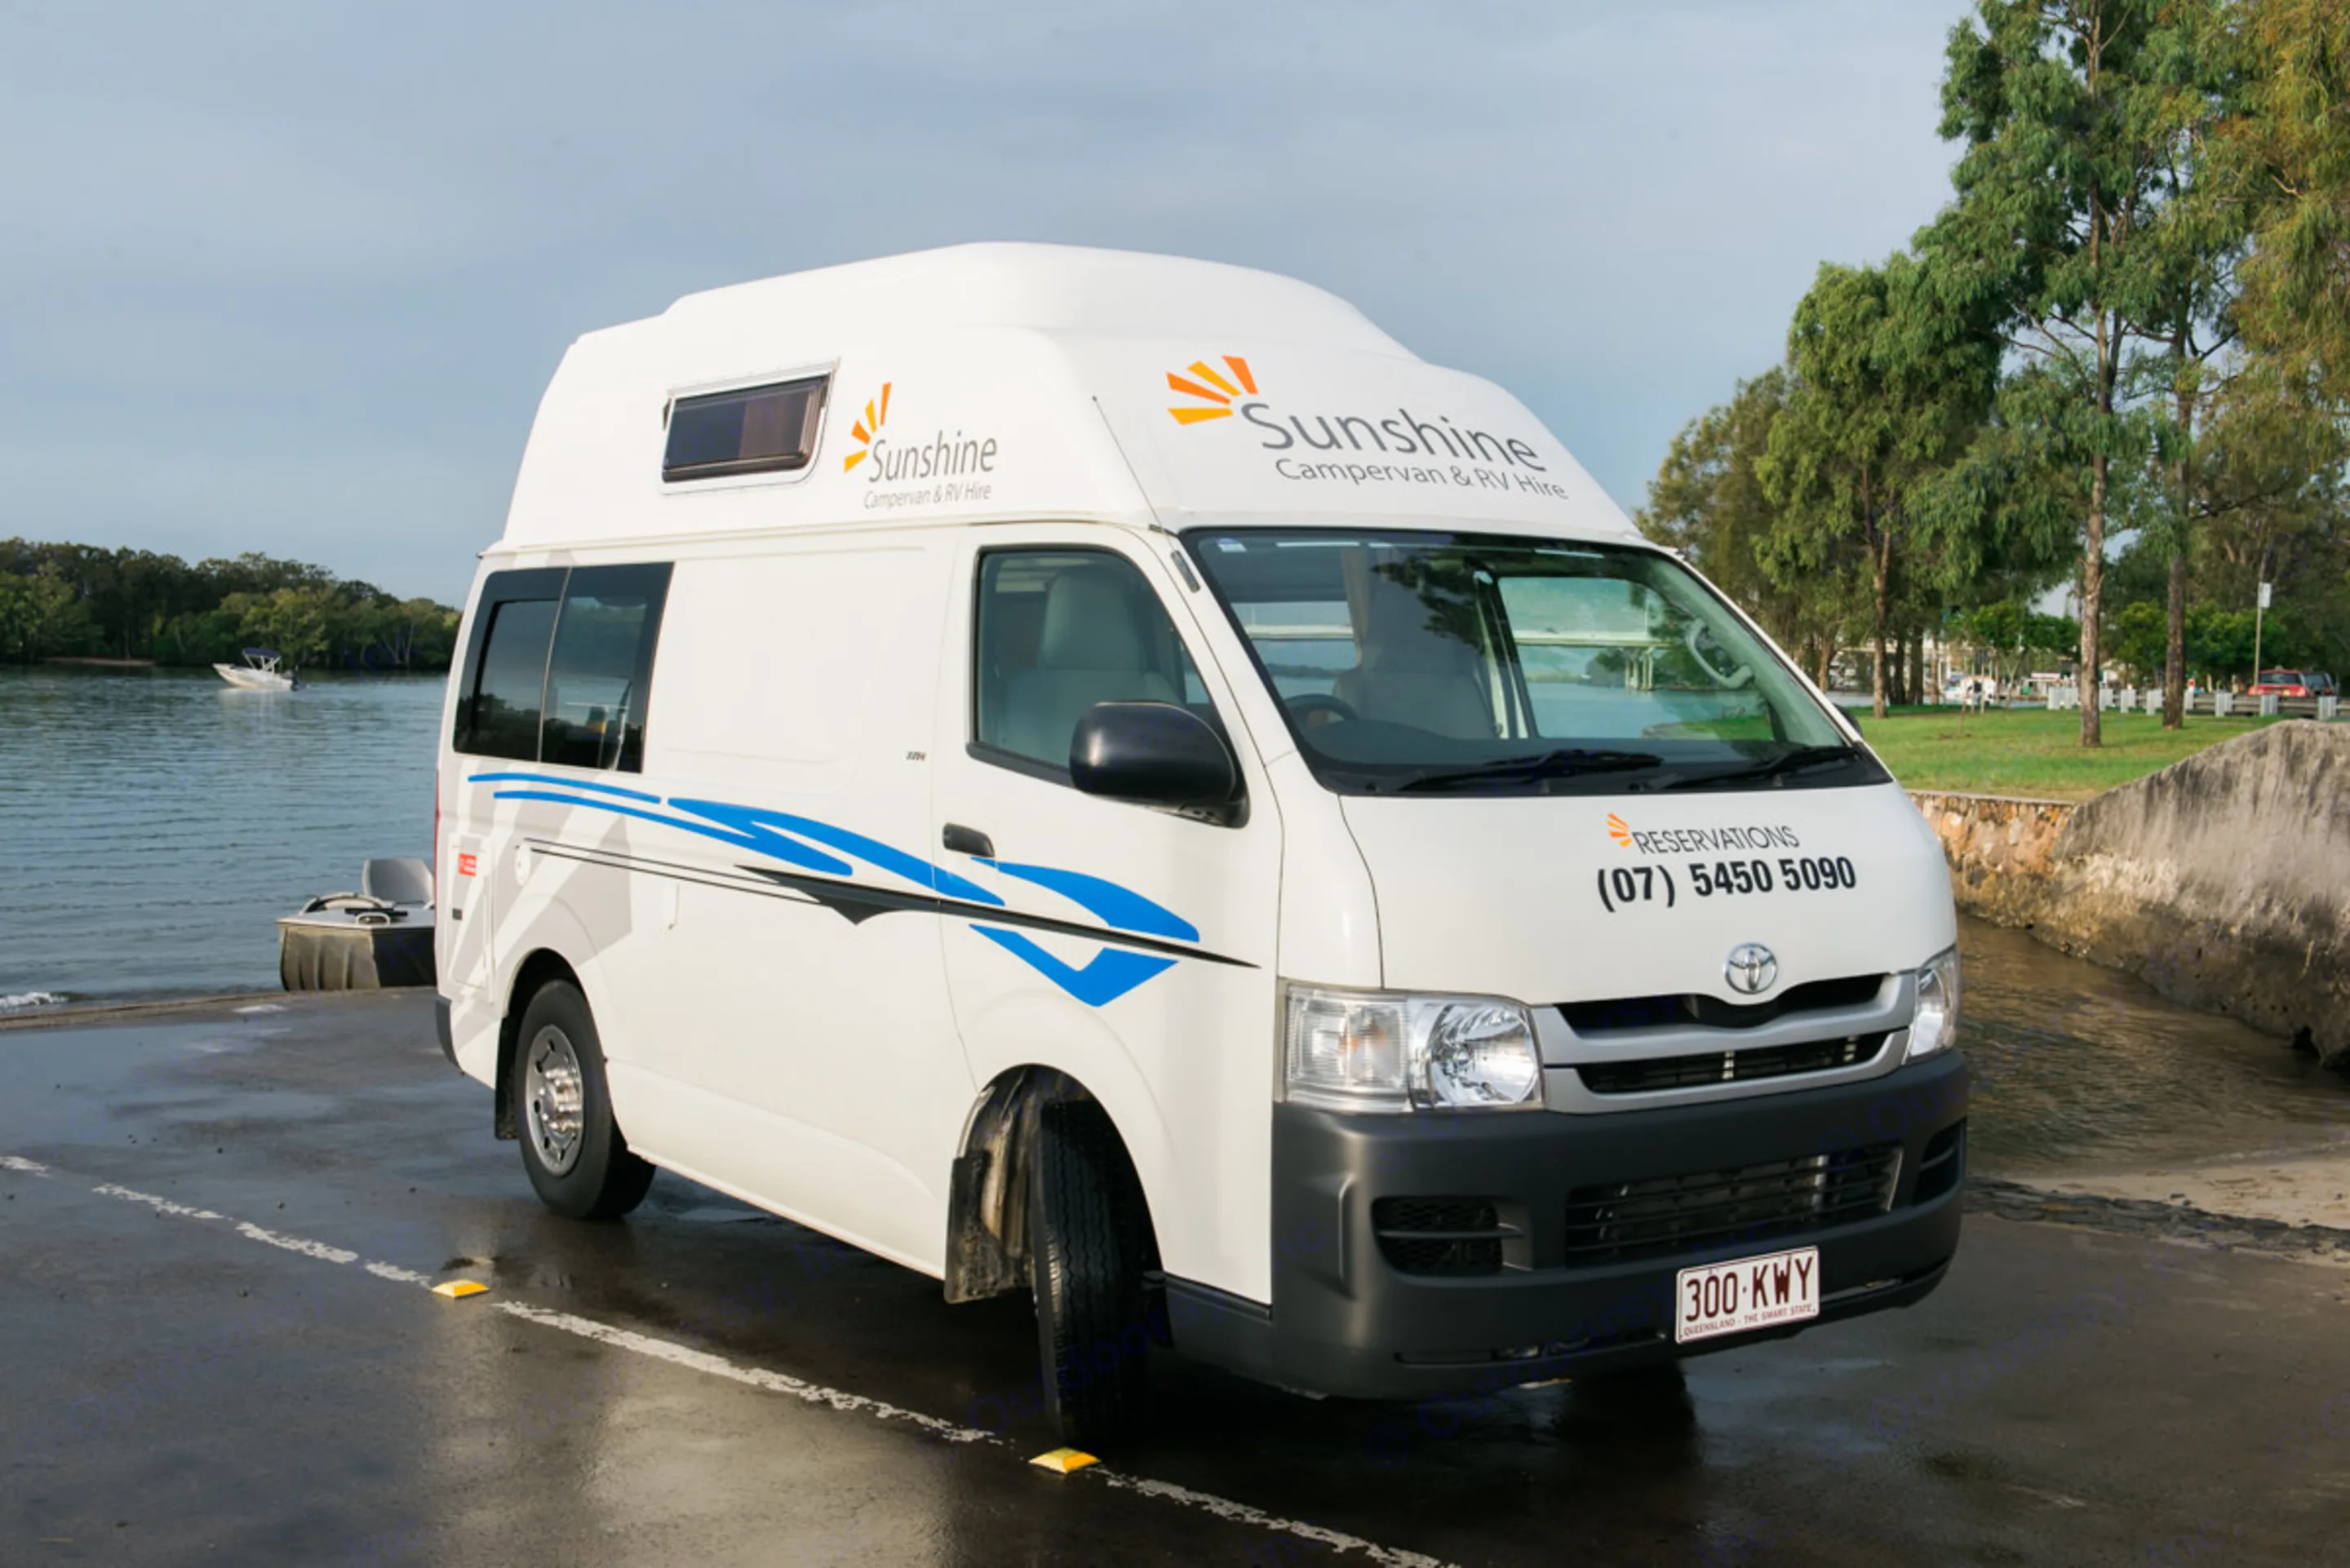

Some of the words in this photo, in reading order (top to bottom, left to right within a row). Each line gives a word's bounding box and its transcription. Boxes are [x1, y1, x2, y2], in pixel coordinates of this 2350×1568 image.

[868, 429, 998, 483] Sunshine
[1239, 401, 1547, 472] Sunshine
[863, 489, 932, 510] Campervan
[933, 485, 942, 504] &
[944, 483, 964, 503] RV
[964, 481, 992, 501] Hire
[1275, 458, 1448, 485] Campervan
[1450, 464, 1471, 487] &
[1474, 467, 1511, 491] RV
[1517, 473, 1570, 500] Hire
[1631, 826, 1801, 855] RESERVATIONS
[1597, 864, 1676, 913] (07)
[1688, 859, 1773, 897] 5450
[1777, 856, 1857, 891] 5090
[1744, 1312, 1758, 1323] THE
